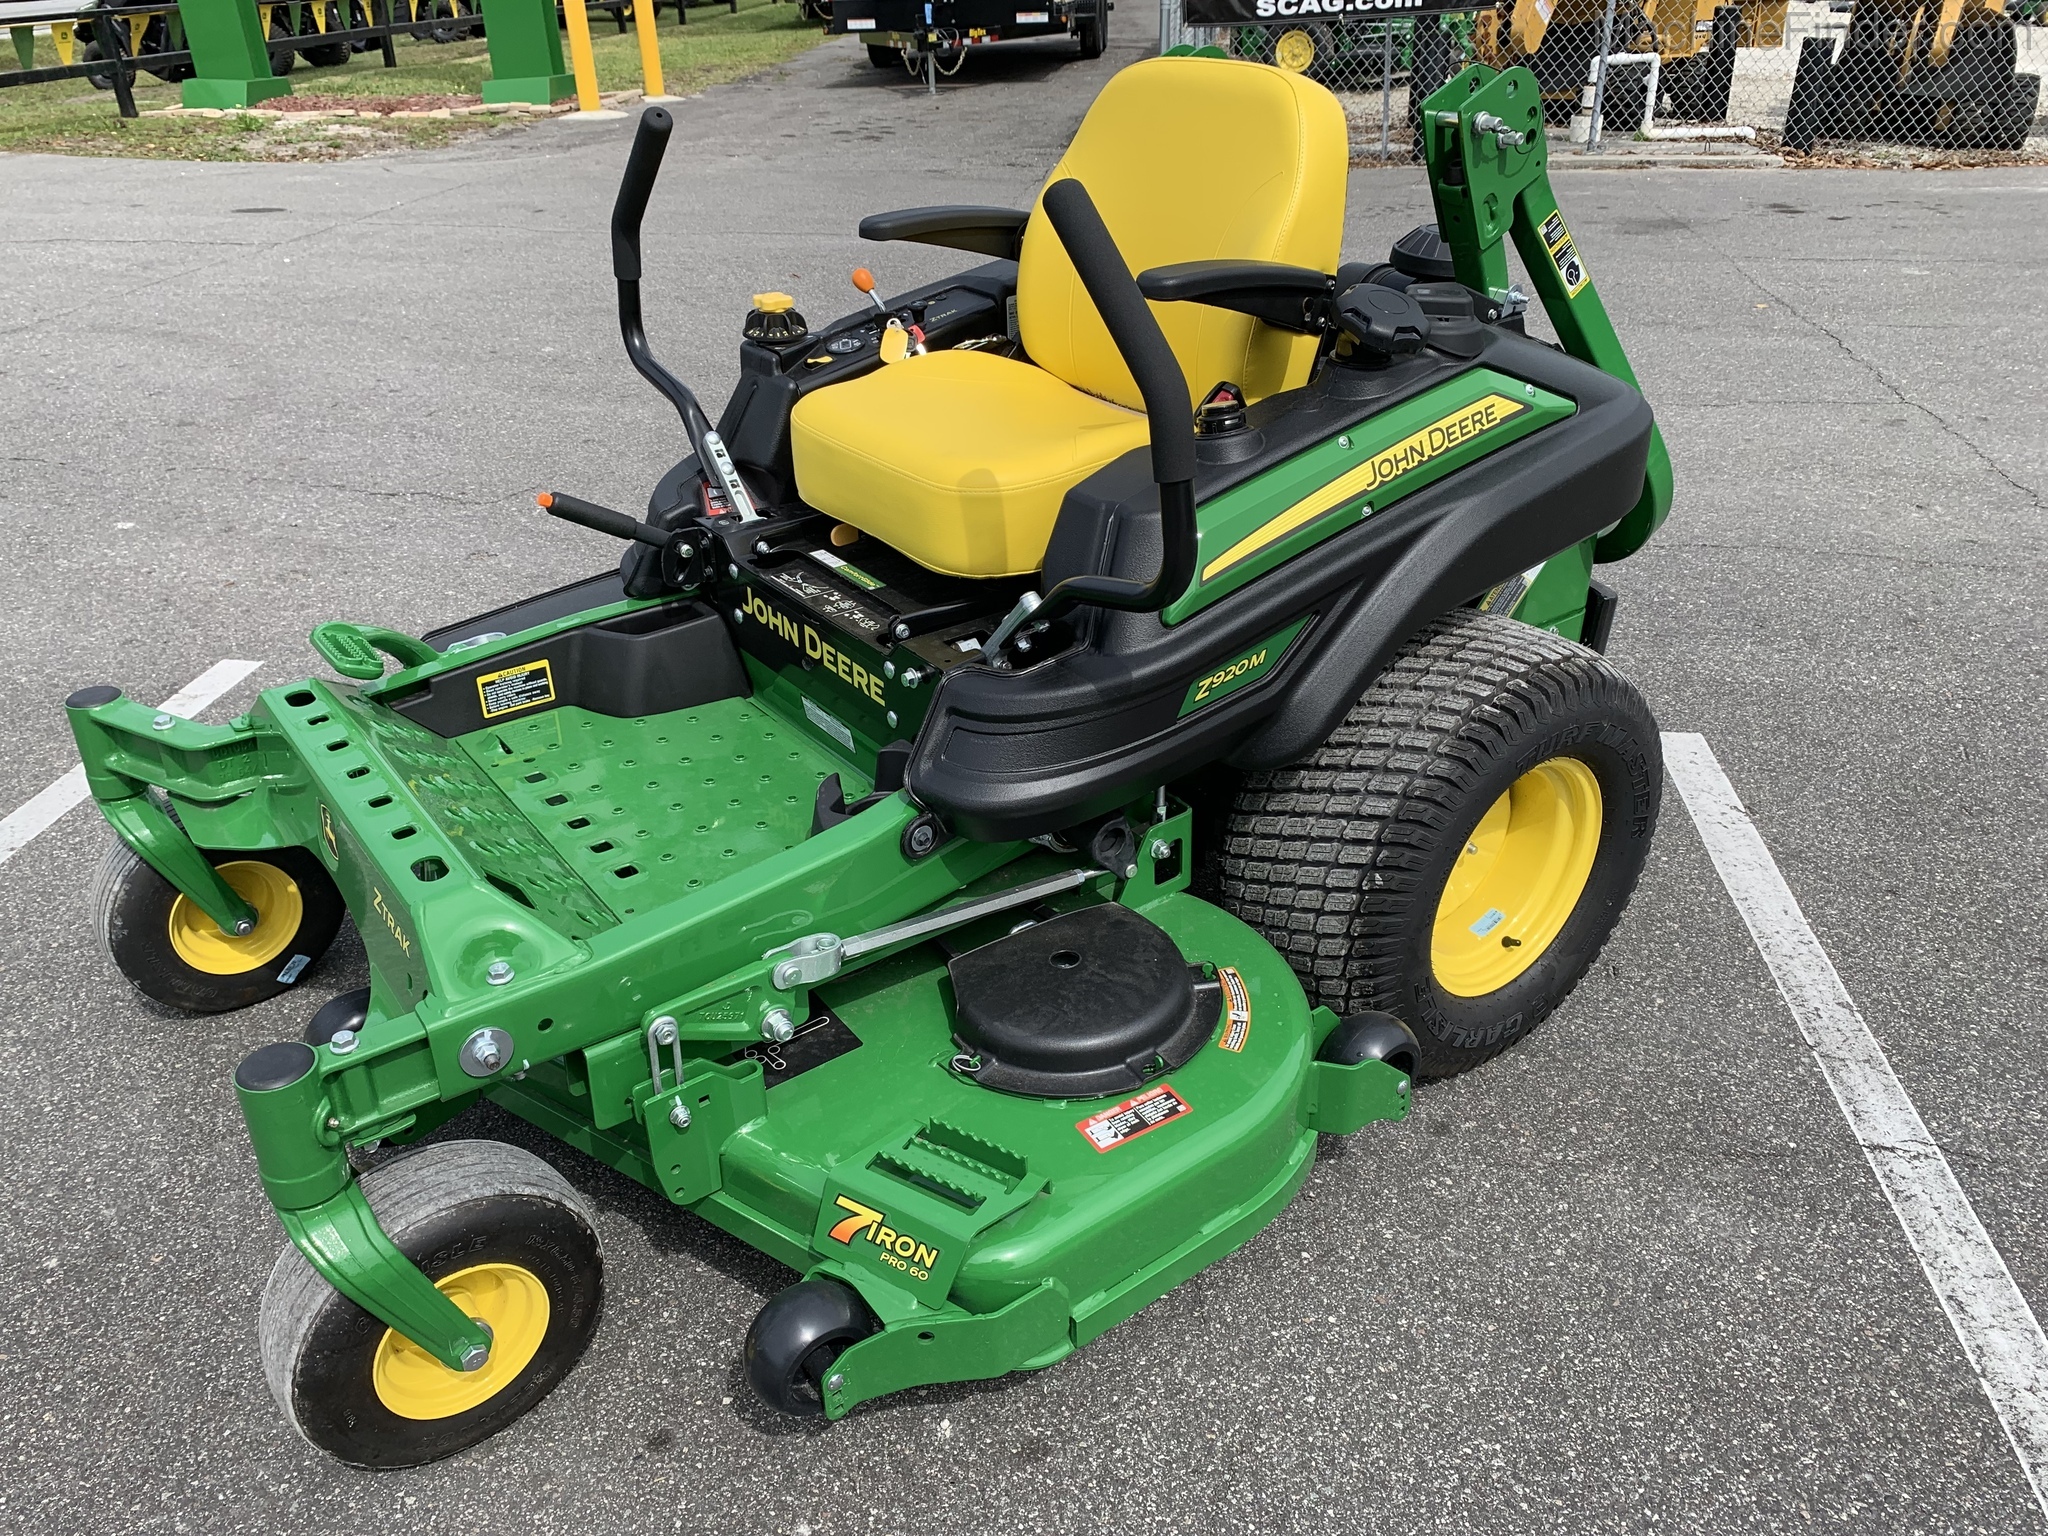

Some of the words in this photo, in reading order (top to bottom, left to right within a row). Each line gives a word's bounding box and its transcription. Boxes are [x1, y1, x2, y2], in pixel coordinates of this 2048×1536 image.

[1366, 440, 1426, 489] JOHN
[1427, 403, 1498, 454] DEERE
[503, 666, 526, 677] CAUTION
[742, 586, 799, 648] JOHN
[803, 623, 886, 707] DEERE
[1194, 648, 1267, 702] Z920M
[1516, 720, 1600, 776] TURF
[1597, 722, 1651, 839] MASTER
[373, 886, 411, 959] ZTRAK
[1413, 975, 1524, 1049] CARLISLE
[828, 1193, 886, 1246] 7
[865, 1220, 940, 1270] IRON
[879, 1251, 908, 1271] PRO
[909, 1265, 929, 1281] 60
